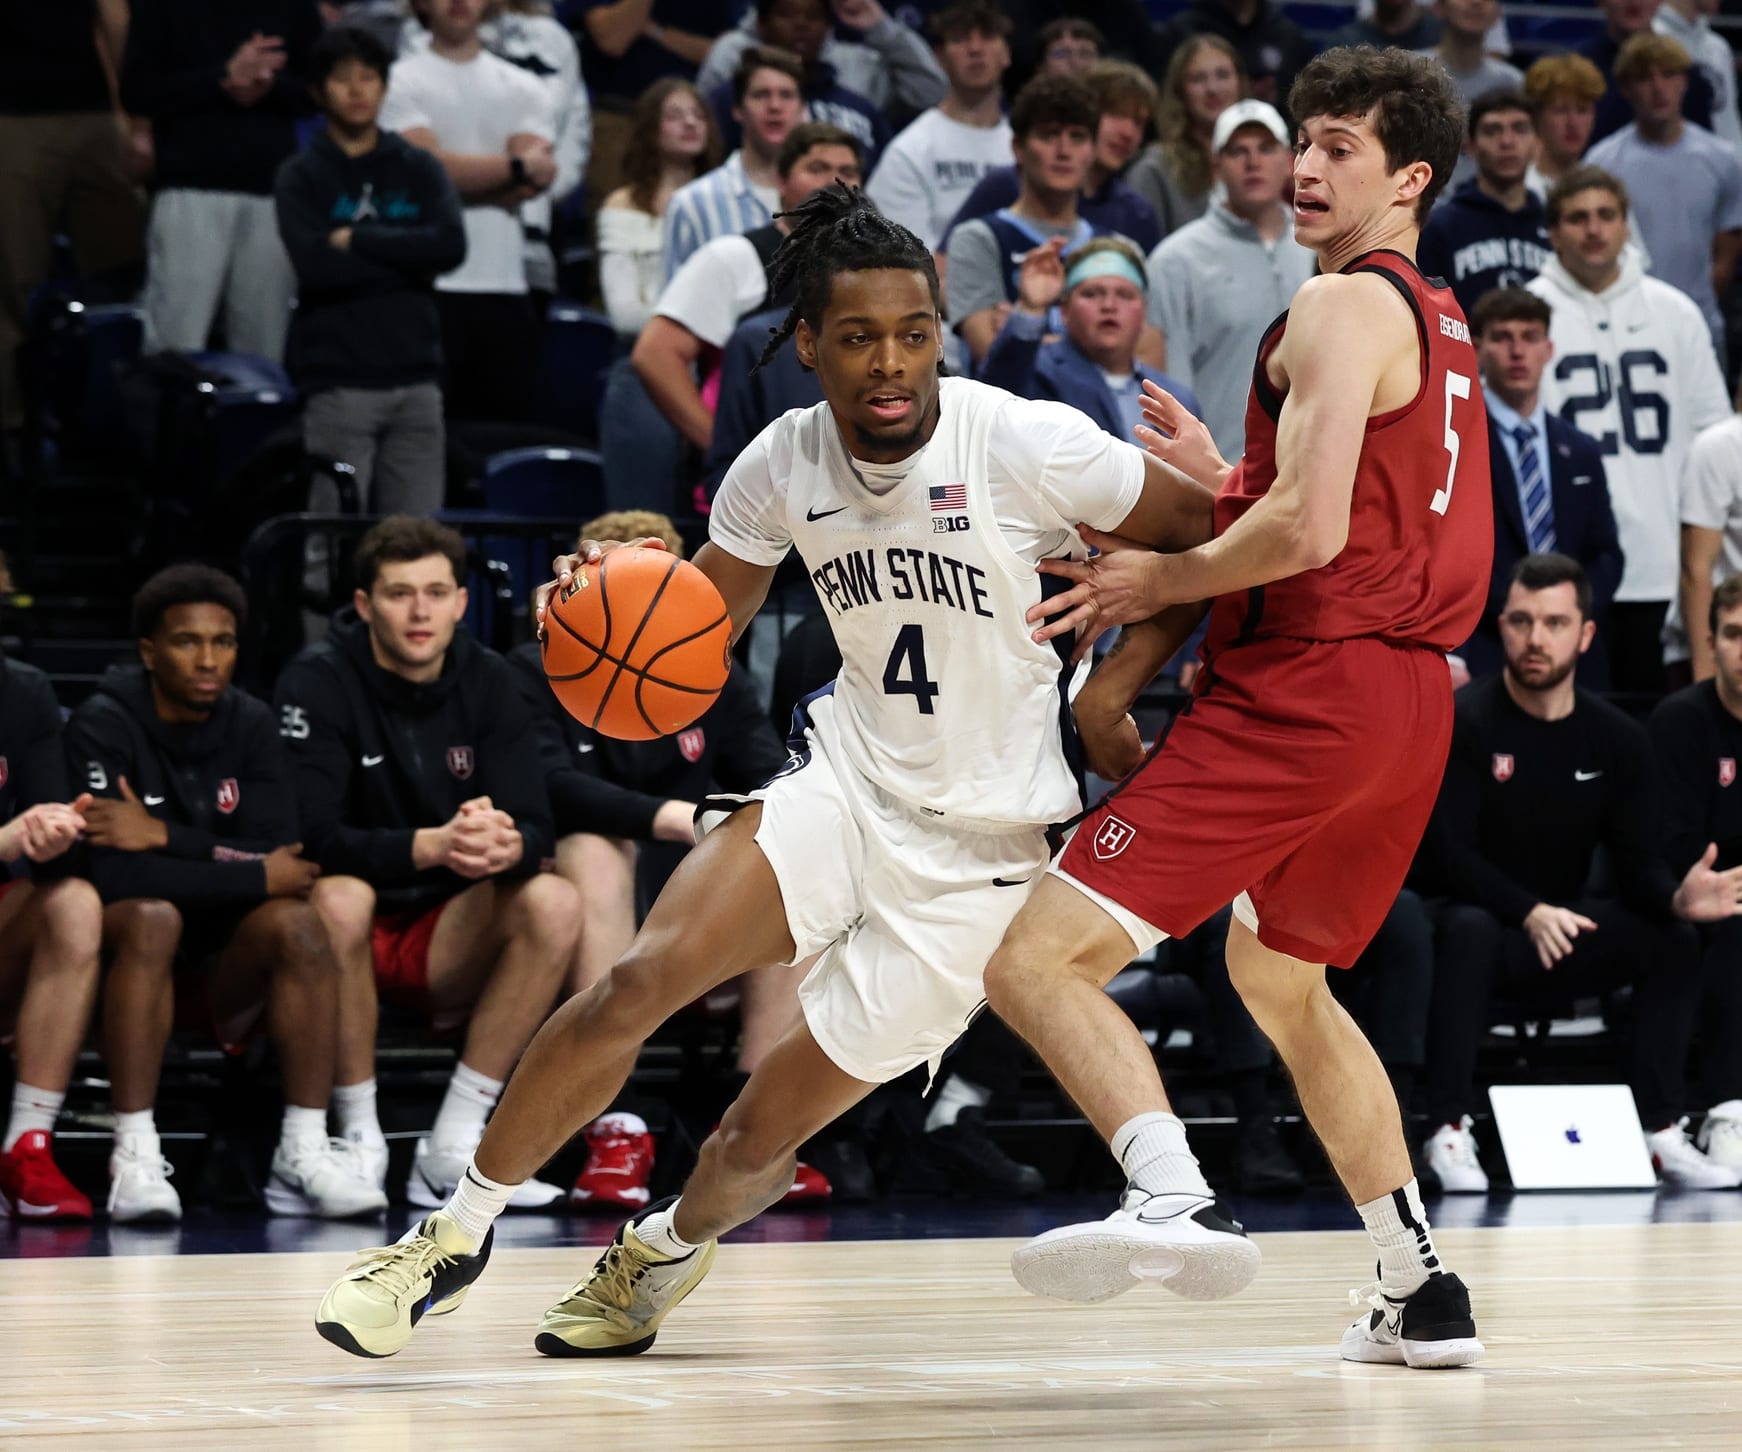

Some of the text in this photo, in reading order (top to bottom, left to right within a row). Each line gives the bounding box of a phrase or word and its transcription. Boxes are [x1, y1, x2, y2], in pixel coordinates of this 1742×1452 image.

[1554, 349, 1670, 456] 26
[1429, 369, 1471, 517] 5
[932, 515, 971, 534] BIG
[811, 547, 994, 619] PENN STATE
[881, 623, 940, 715] 4
[87, 760, 109, 791] 3
[1098, 821, 1127, 851] H
